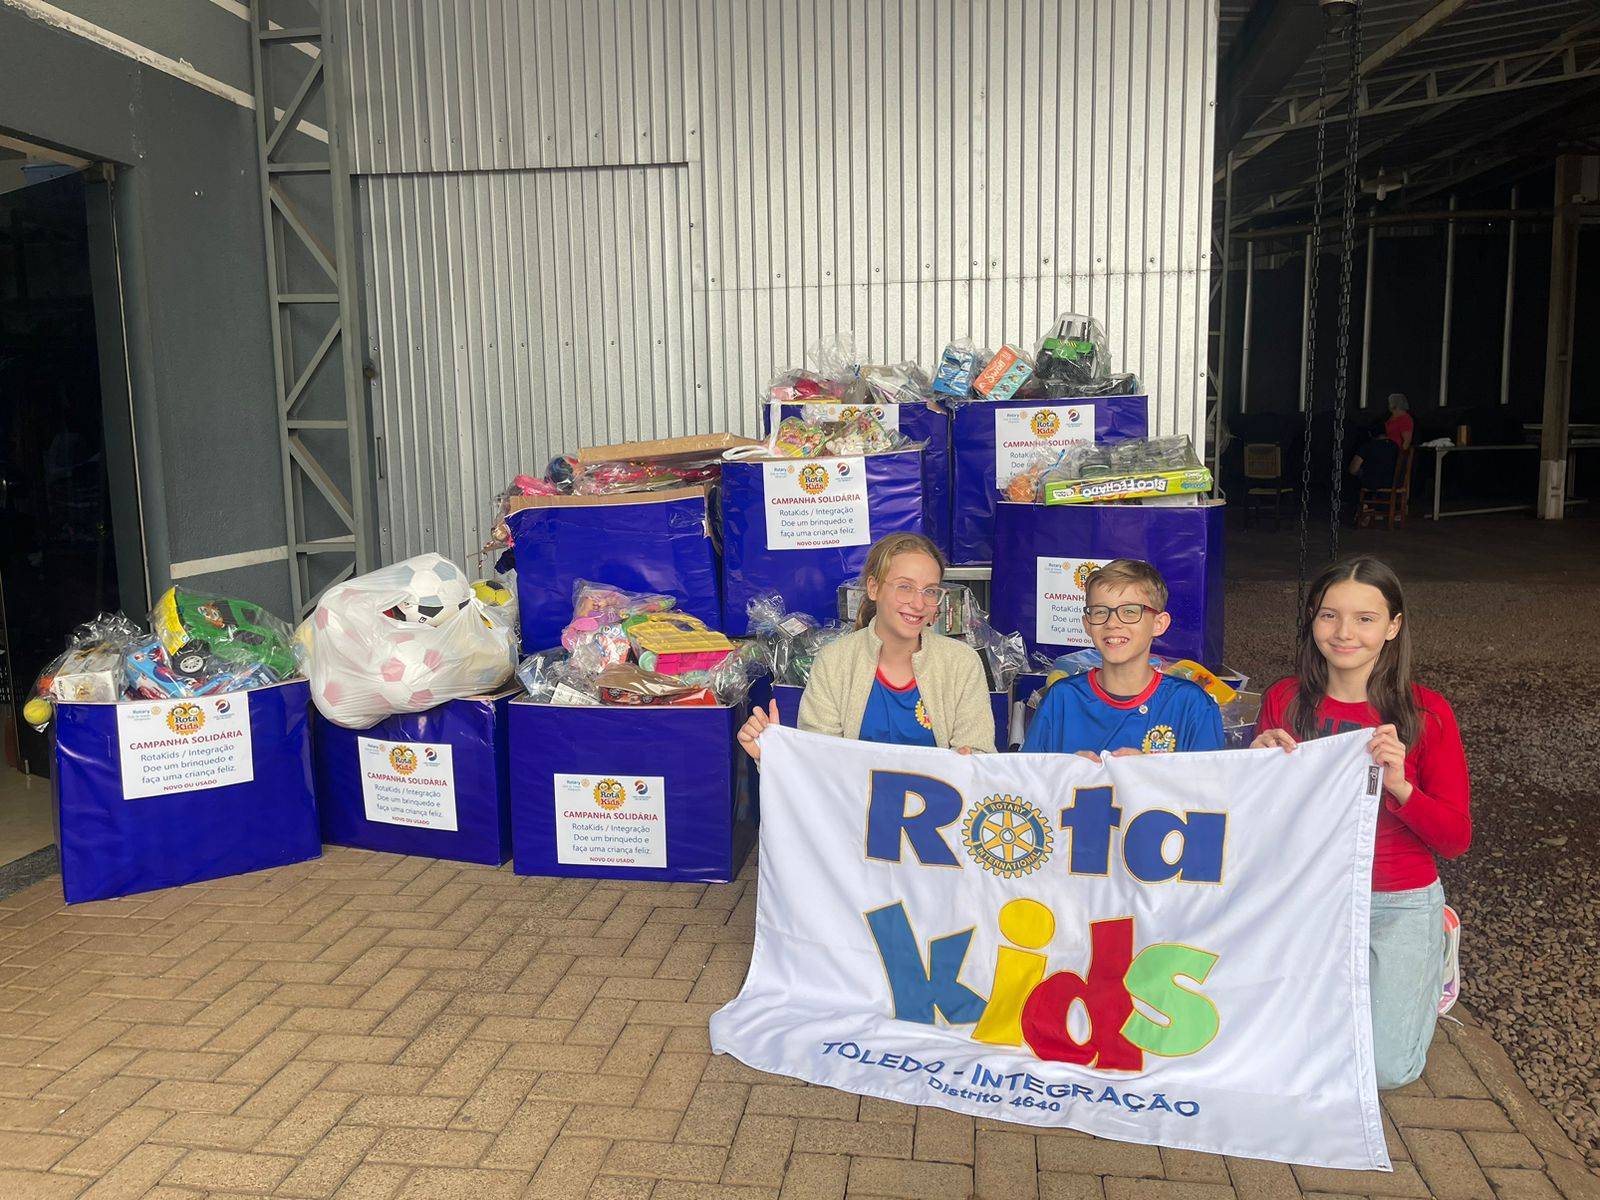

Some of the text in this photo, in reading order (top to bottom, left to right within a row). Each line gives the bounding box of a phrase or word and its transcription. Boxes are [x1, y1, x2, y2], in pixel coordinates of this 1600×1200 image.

[1082, 481, 1135, 497] FECHADO
[1137, 478, 1167, 492] BICO
[818, 494, 860, 503] SOLIDÁRIA
[816, 506, 853, 516] Integração
[810, 518, 846, 526] brinquedo
[1045, 593, 1086, 601] CAMPANH
[130, 730, 243, 750] CAMPANHA SOLIDÁRIA
[141, 752, 179, 762] RotaKids
[189, 744, 234, 757] Integração
[143, 764, 162, 773] Doe
[181, 756, 225, 768] brinquedo
[185, 769, 214, 779] criança
[368, 772, 406, 782] CAMPANHA
[375, 784, 401, 793] RotaKids
[406, 787, 440, 798] Integração
[402, 796, 434, 806] brinquedo
[406, 808, 427, 816] criança
[991, 802, 1027, 813] ROTARY
[564, 811, 658, 821] CAMPANHA SOLIDÁRIA
[611, 824, 650, 833] Integração
[605, 835, 642, 845] brinquedo
[573, 844, 587, 853] faça
[607, 847, 632, 855] criança
[977, 848, 1040, 870] INTERNATIONAL
[863, 898, 1220, 1071] kids
[823, 1041, 945, 1073] TOLEDO
[971, 1063, 1200, 1117] INTEGRAÇÃO
[928, 1076, 1061, 1112] Distrito 4640
